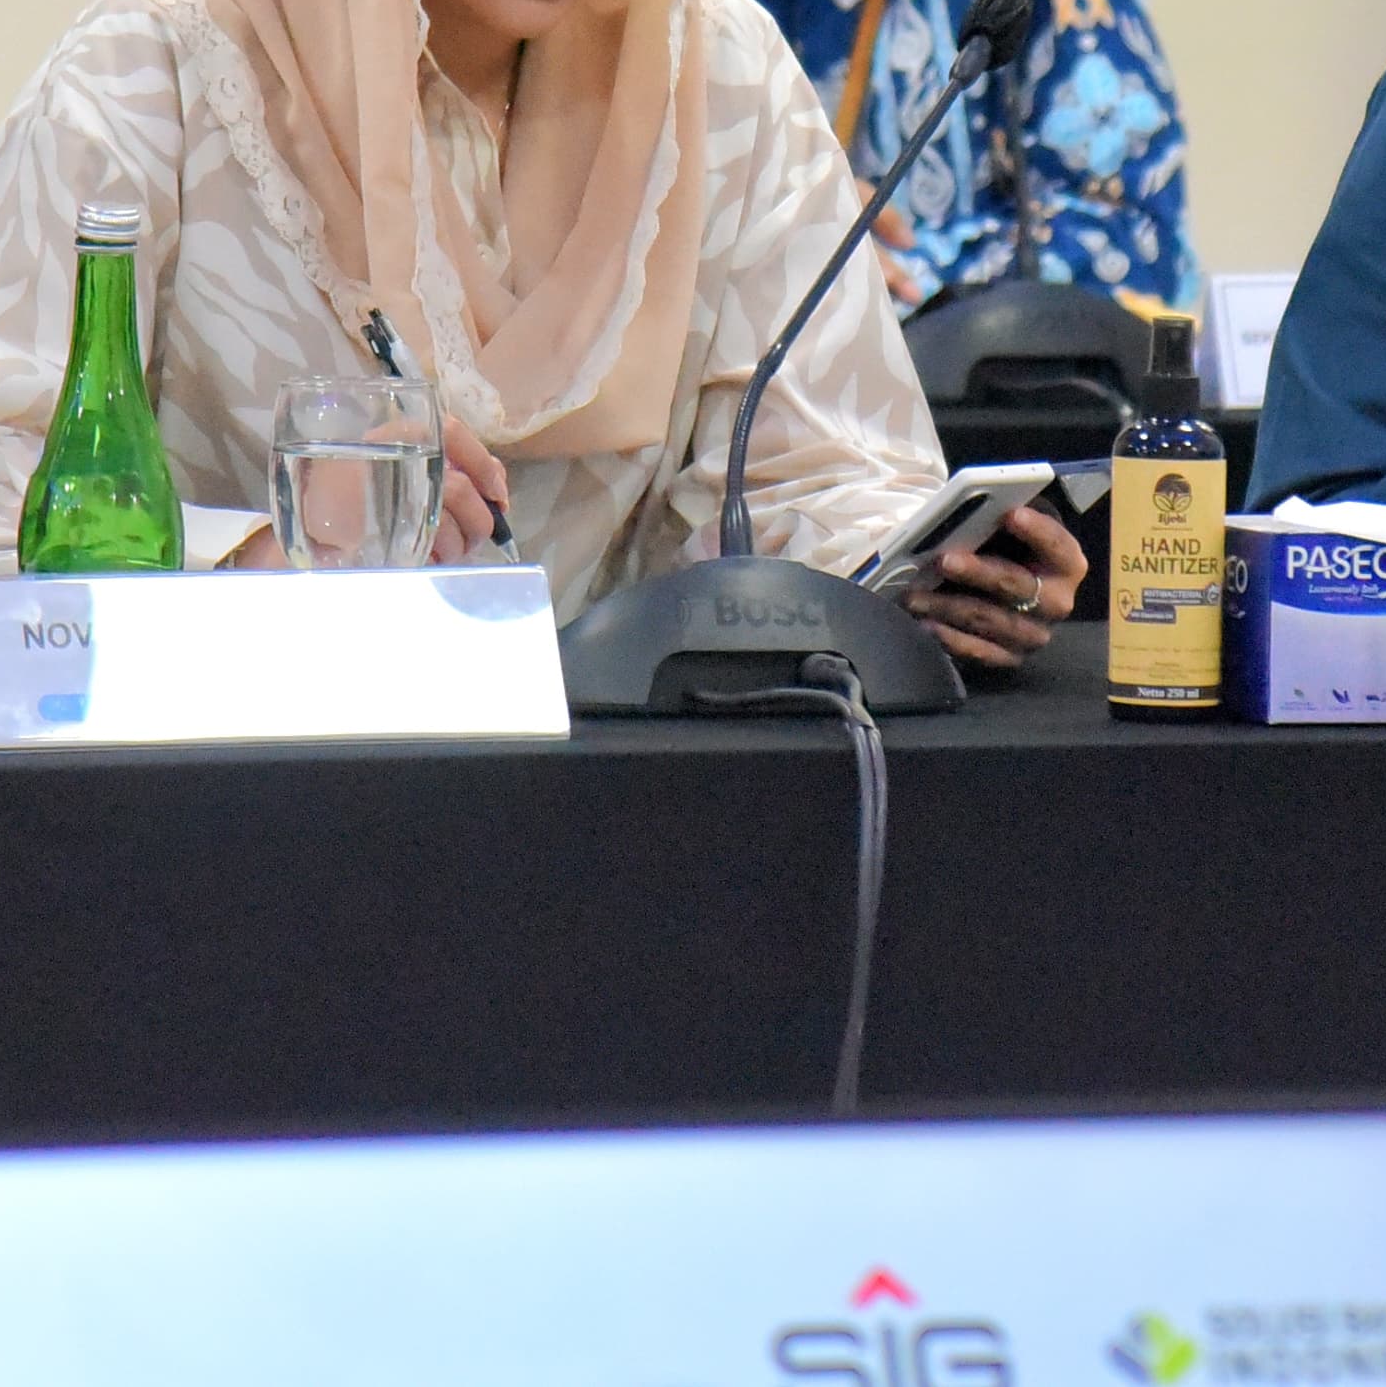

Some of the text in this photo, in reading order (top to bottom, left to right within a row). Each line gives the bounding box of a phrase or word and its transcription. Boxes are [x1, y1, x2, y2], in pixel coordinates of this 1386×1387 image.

[1141, 537, 1201, 555] HAND
[1120, 554, 1219, 575] SANITIZER
[773, 1320, 1013, 1387] SIG
